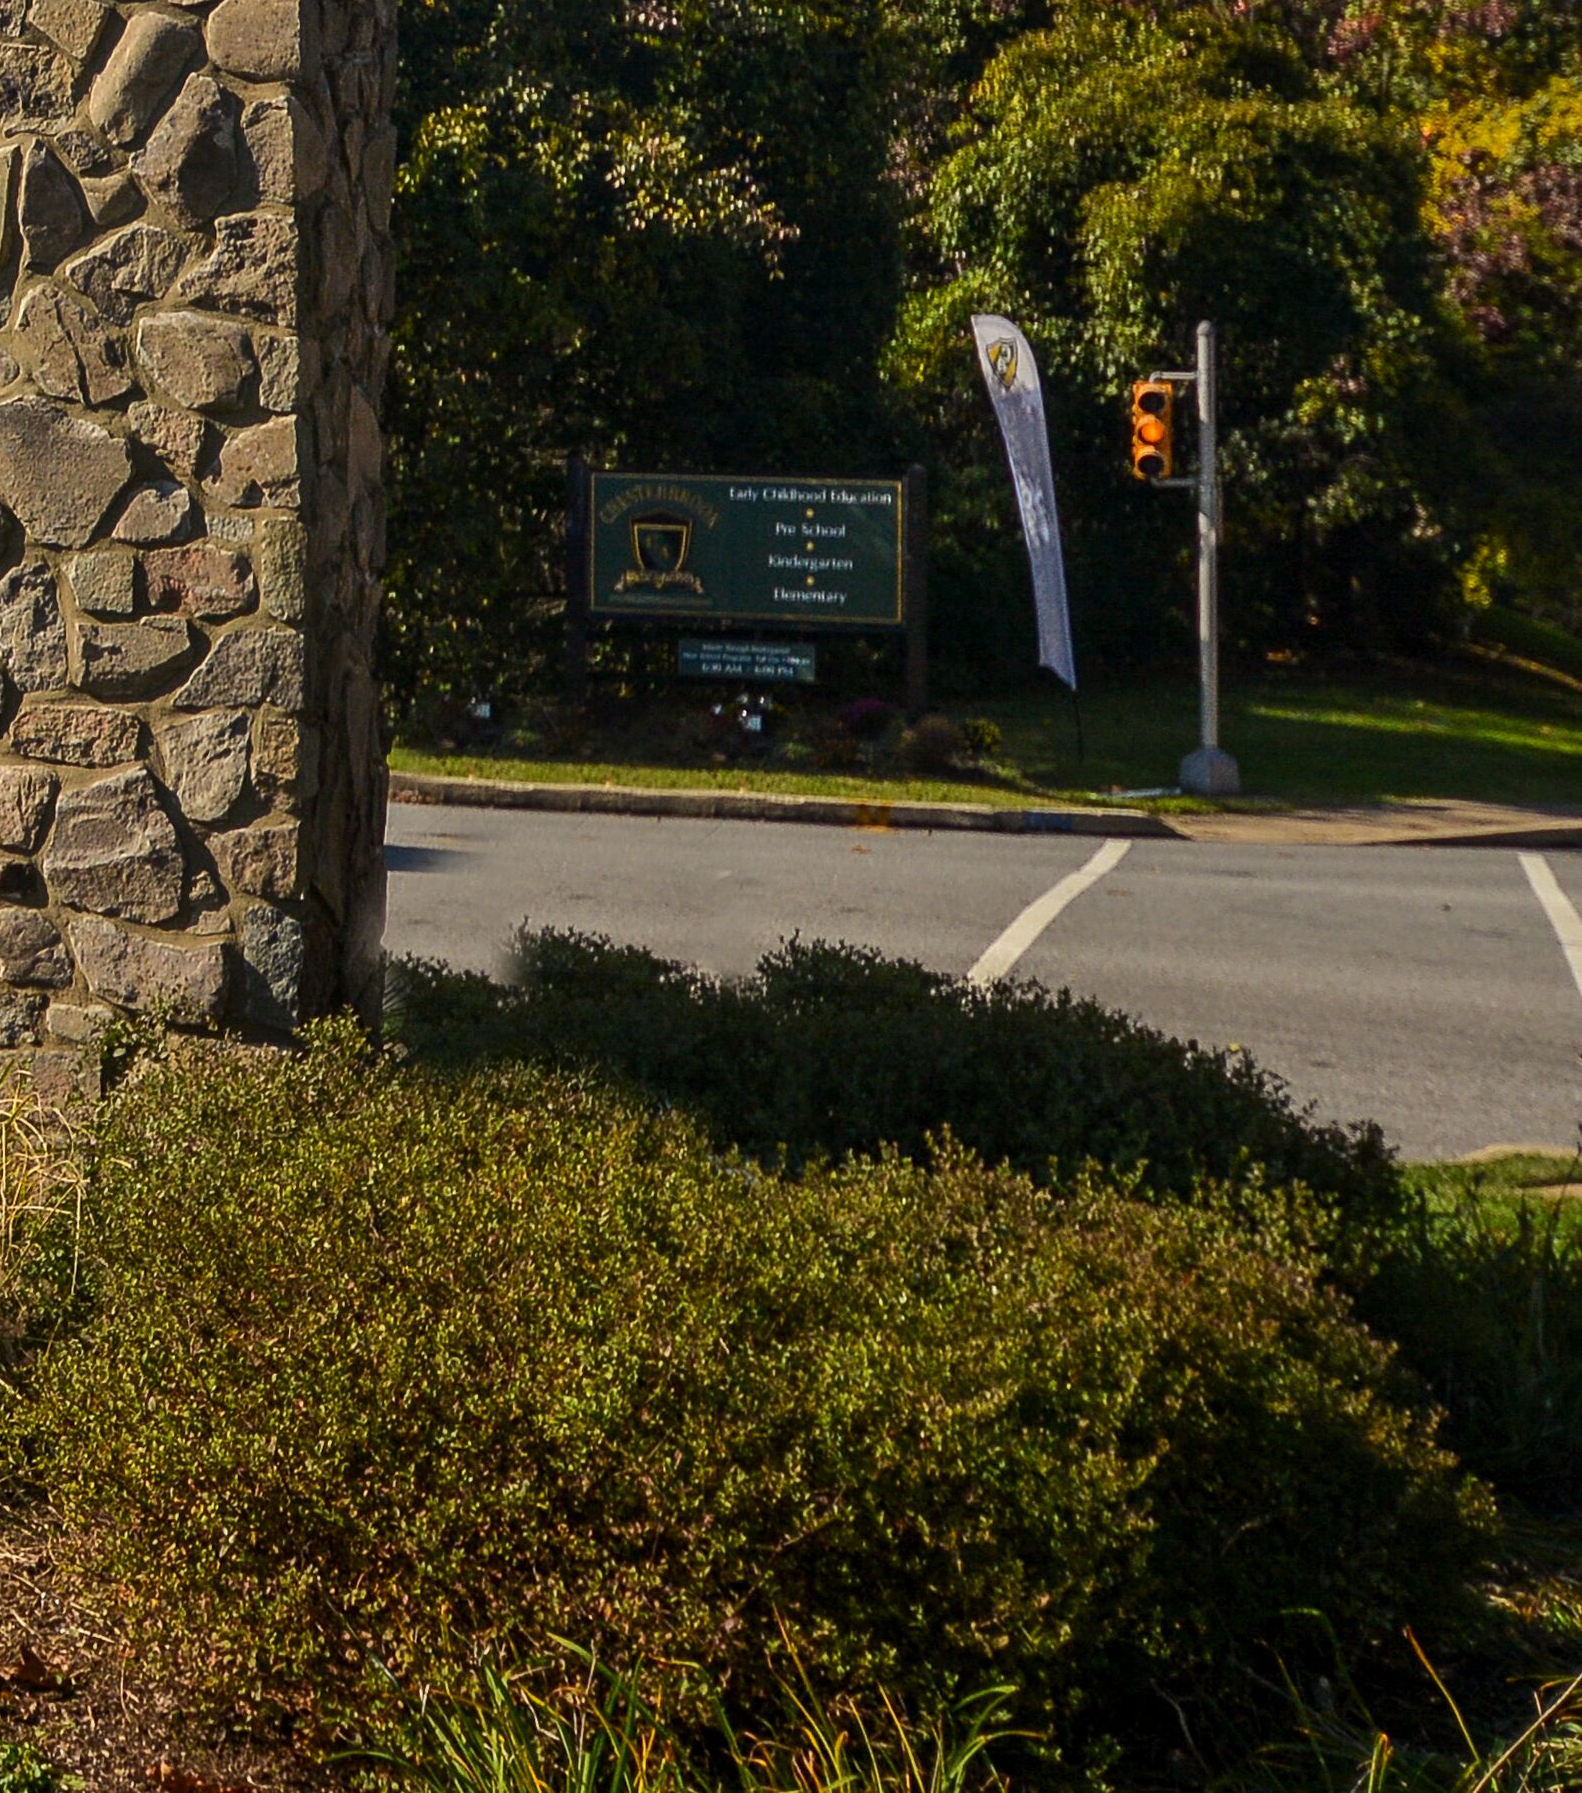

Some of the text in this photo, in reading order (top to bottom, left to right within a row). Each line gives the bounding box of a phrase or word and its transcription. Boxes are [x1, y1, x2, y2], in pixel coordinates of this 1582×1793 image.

[730, 487, 892, 506] Early Childhood Education
[775, 522, 846, 538] Pre School
[768, 555, 853, 572] Kindergarten
[774, 588, 847, 605] Elementary
